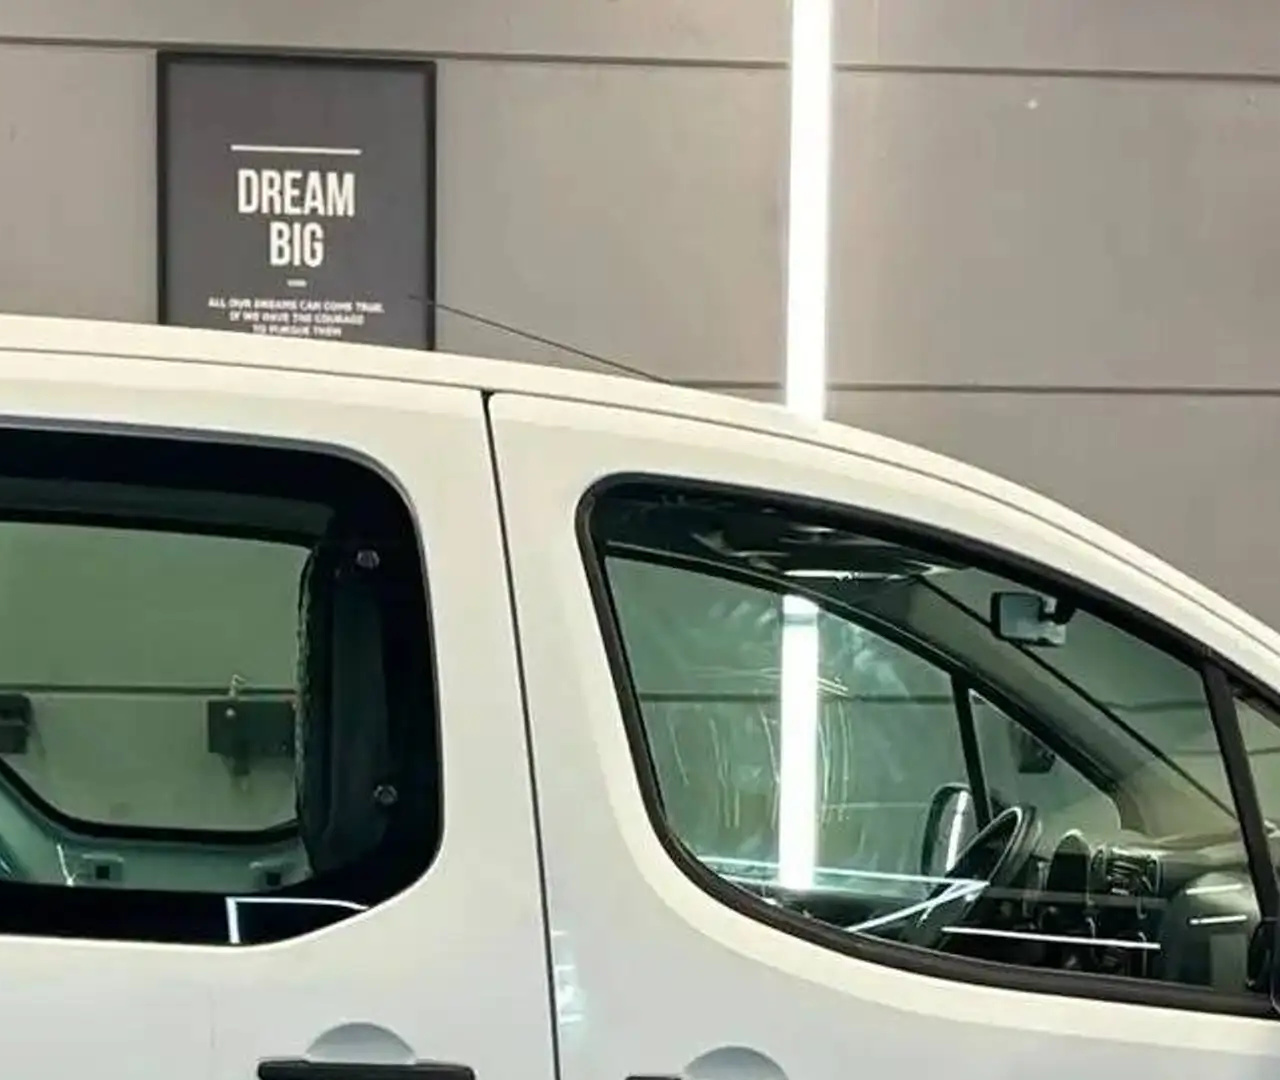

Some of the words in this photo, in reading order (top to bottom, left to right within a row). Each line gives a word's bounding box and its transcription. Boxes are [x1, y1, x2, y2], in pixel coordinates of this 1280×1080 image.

[237, 169, 356, 218] DREAM
[269, 222, 325, 268] BIG
[208, 297, 226, 308] ALL
[228, 298, 252, 309] OUR
[254, 298, 297, 310] DREAMS
[299, 300, 321, 311] CAN
[323, 301, 352, 311] COME
[242, 311, 260, 322] WE
[261, 312, 290, 323] HAVE
[292, 313, 312, 324] THE
[314, 314, 365, 326] COURAGE
